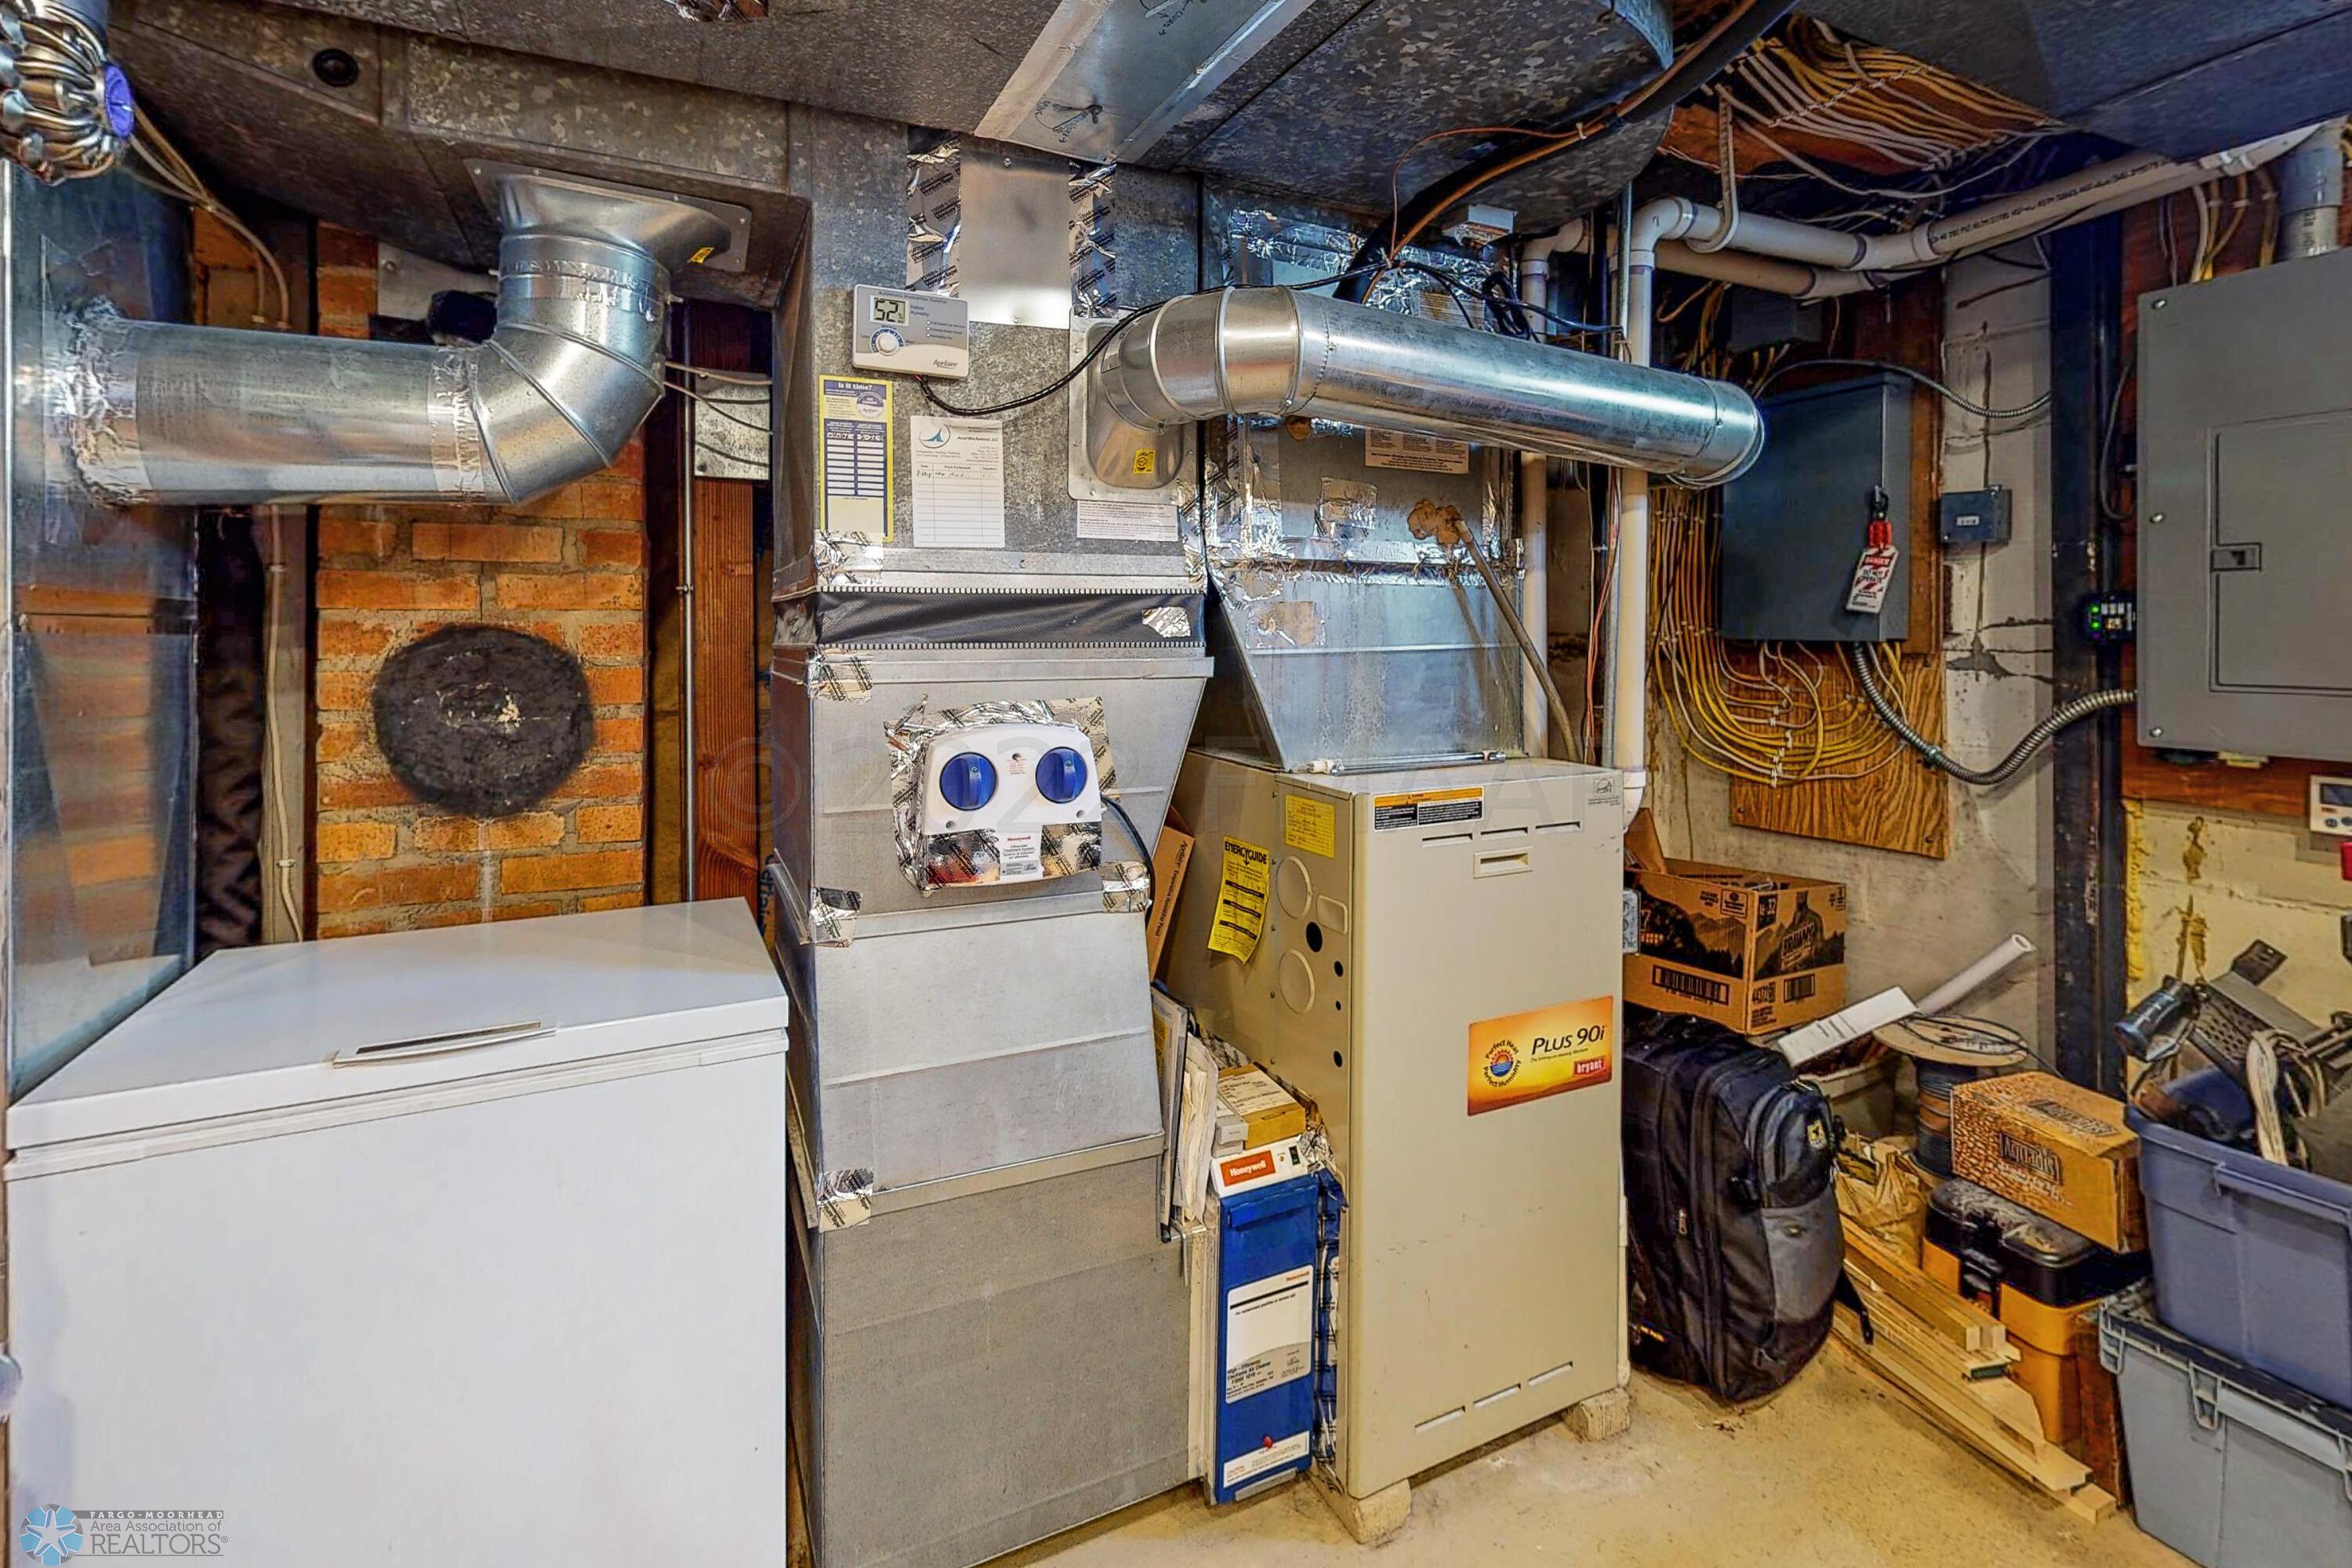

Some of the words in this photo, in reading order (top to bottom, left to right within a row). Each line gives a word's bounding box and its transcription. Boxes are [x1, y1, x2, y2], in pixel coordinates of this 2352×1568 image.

[874, 299, 898, 322] 52
[1577, 1025, 1606, 1045] 90i
[1577, 1060, 1602, 1074] bryant
[1229, 1160, 1267, 1178] Honeywell
